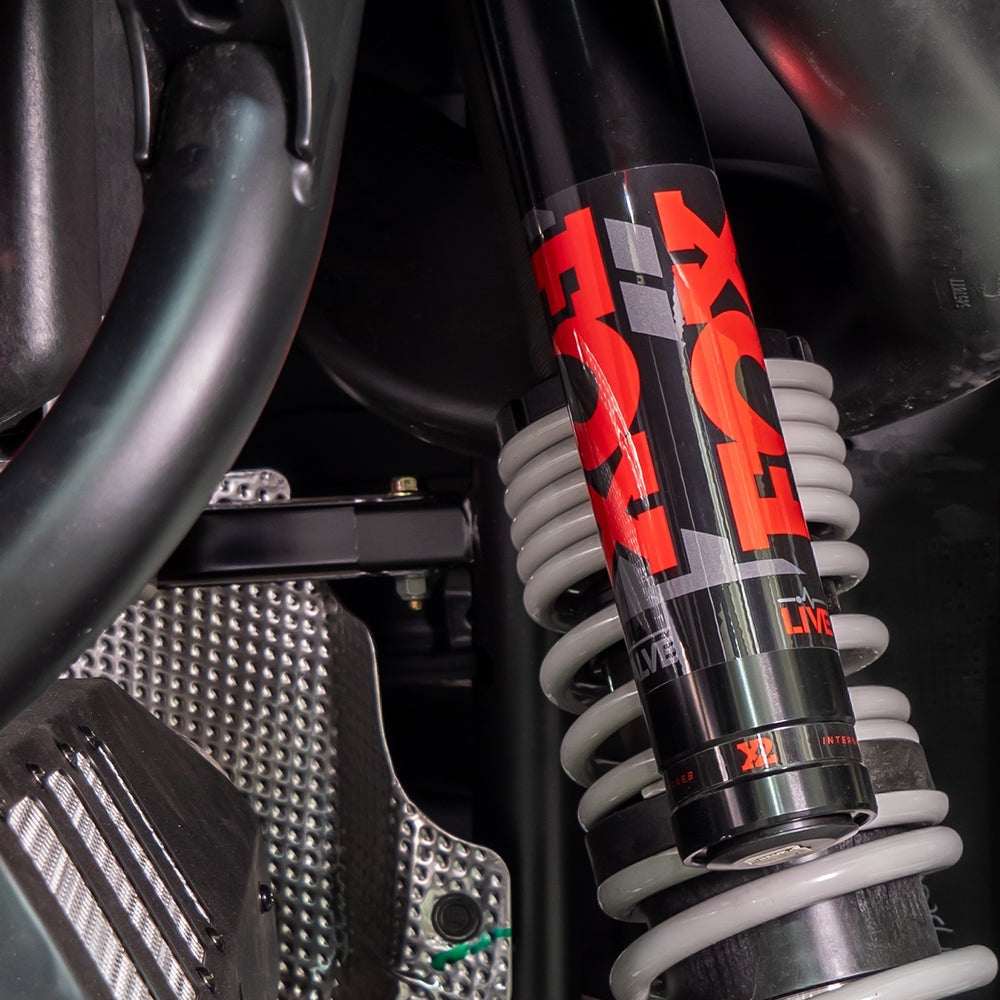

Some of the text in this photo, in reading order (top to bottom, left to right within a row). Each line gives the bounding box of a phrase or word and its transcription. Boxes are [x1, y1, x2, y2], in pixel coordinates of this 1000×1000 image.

[532, 206, 678, 576] FOX
[654, 190, 811, 553] FOX
[780, 605, 833, 637] LIVE
[736, 737, 779, 772] X2
